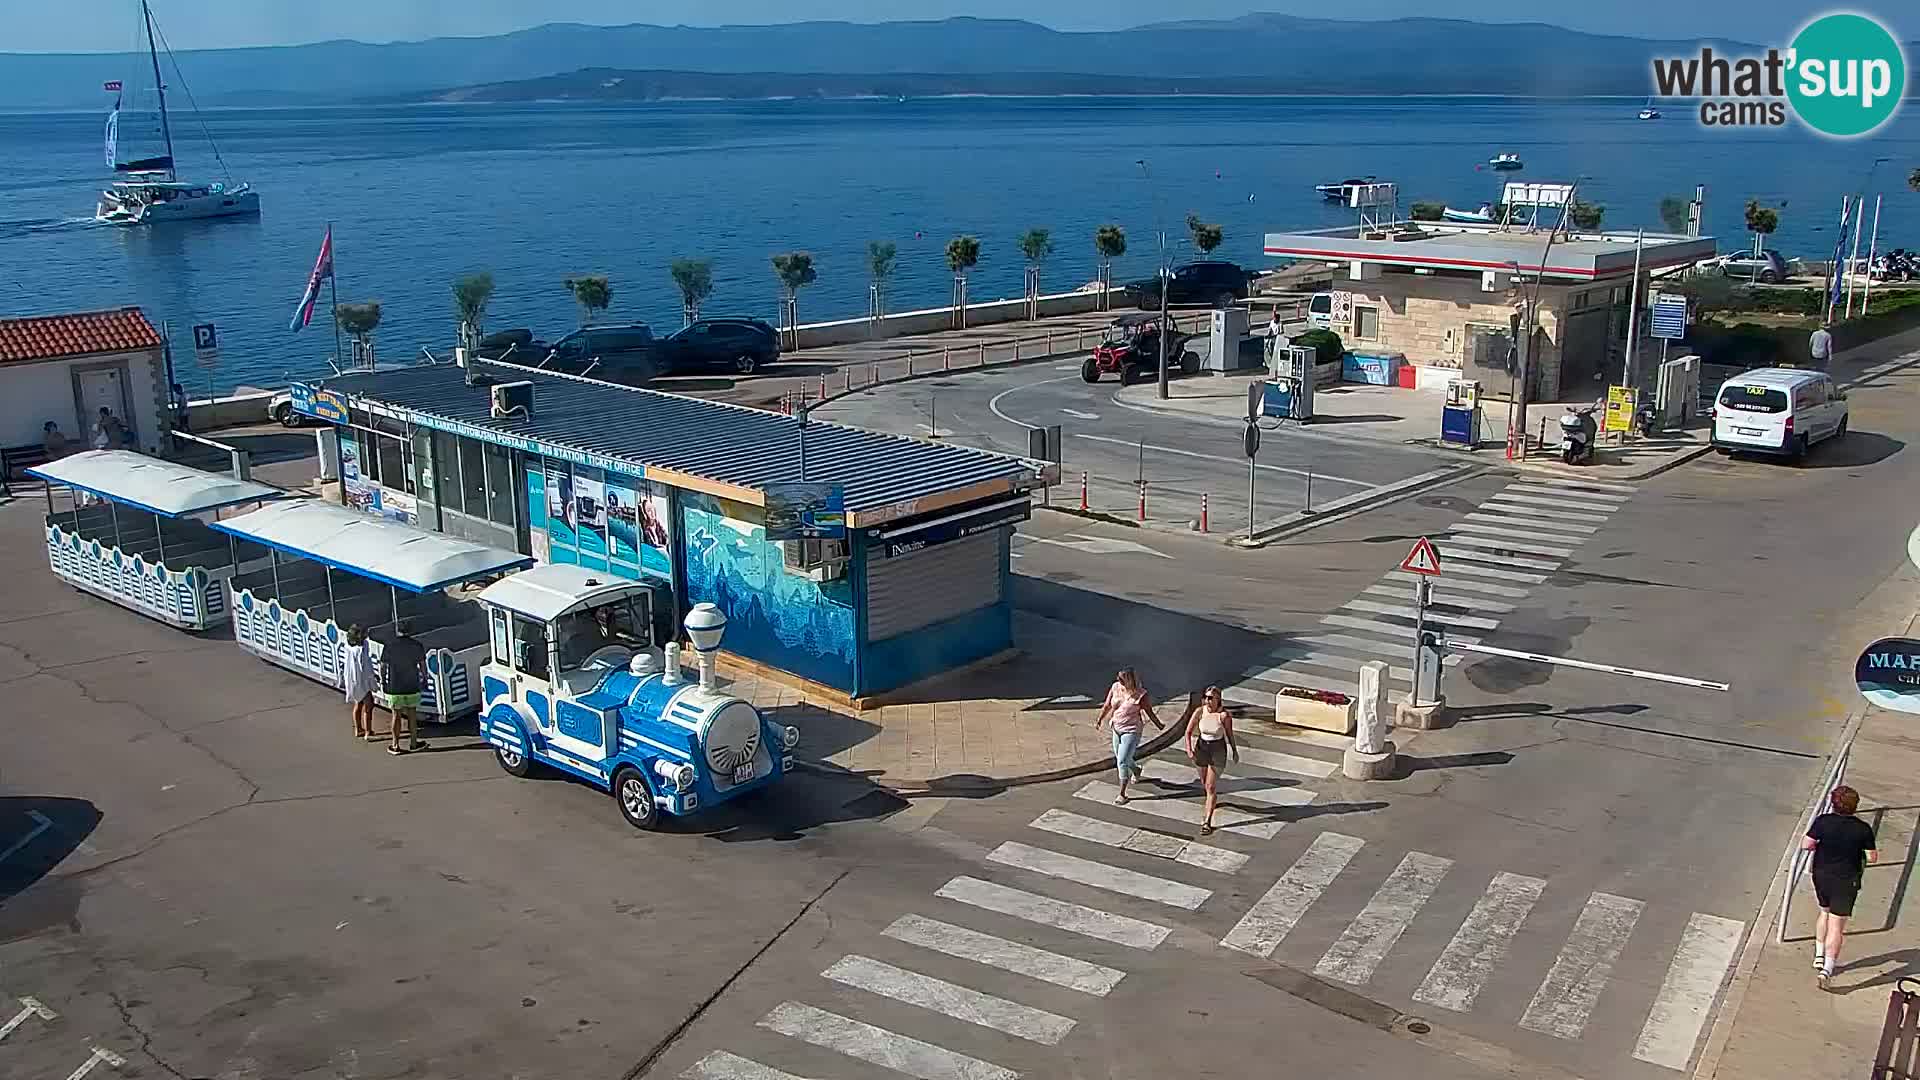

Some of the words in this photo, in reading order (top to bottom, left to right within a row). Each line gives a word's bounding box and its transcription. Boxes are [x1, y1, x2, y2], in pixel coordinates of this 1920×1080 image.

[198, 328, 210, 346] P
[1746, 387, 1766, 396] TAXI
[497, 434, 529, 451] POSTAJA
[538, 443, 553, 456] BUS
[553, 447, 586, 464] STATION
[586, 454, 614, 470] TICKET
[614, 460, 641, 476] OFFICE
